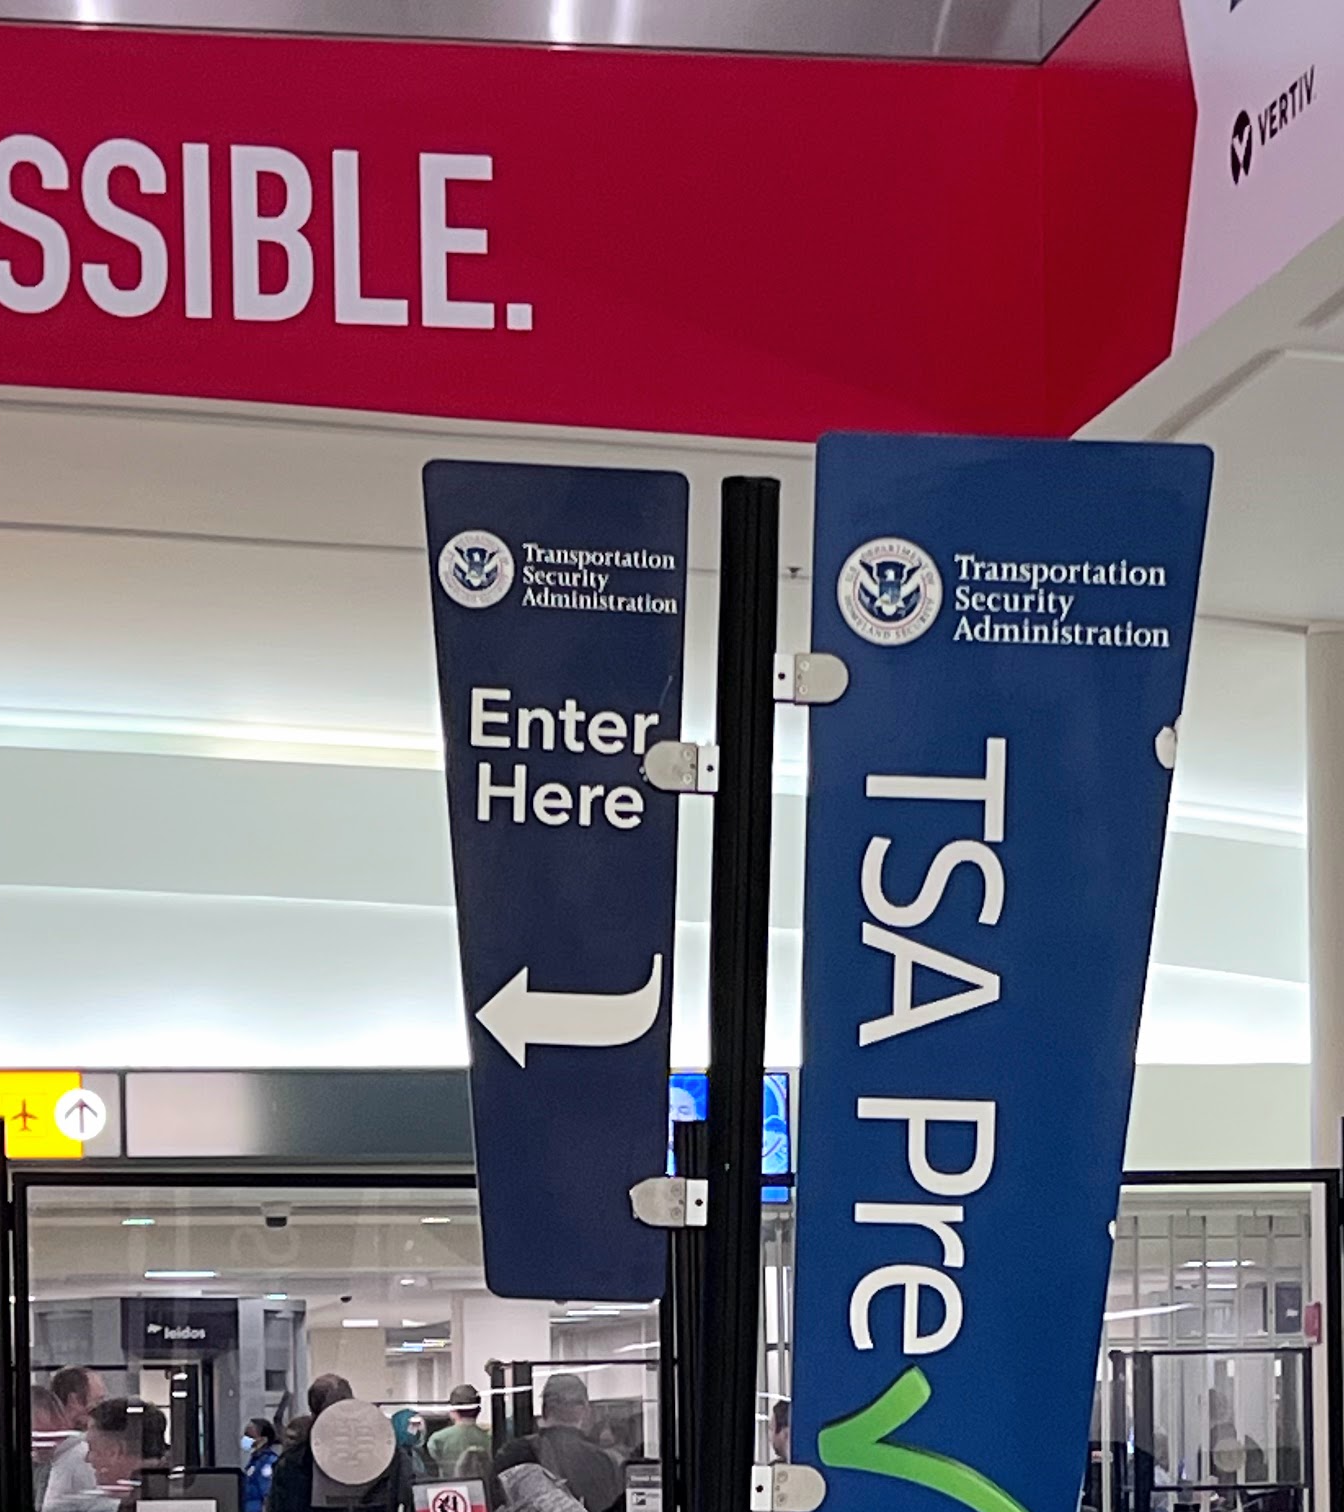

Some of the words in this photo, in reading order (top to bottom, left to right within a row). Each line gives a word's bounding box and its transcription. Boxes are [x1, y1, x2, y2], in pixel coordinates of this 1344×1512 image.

[1258, 65, 1315, 146] VERTIV
[522, 542, 677, 569] Transportation
[954, 553, 1167, 588] Transportation
[522, 565, 609, 594] Security
[521, 586, 679, 615] Administration
[954, 586, 1075, 622] Security
[953, 615, 1171, 648] Administration
[470, 687, 660, 755] Enter
[476, 761, 645, 830] Here
[858, 736, 1006, 1046] TSA
[849, 1096, 997, 1355] Pre
